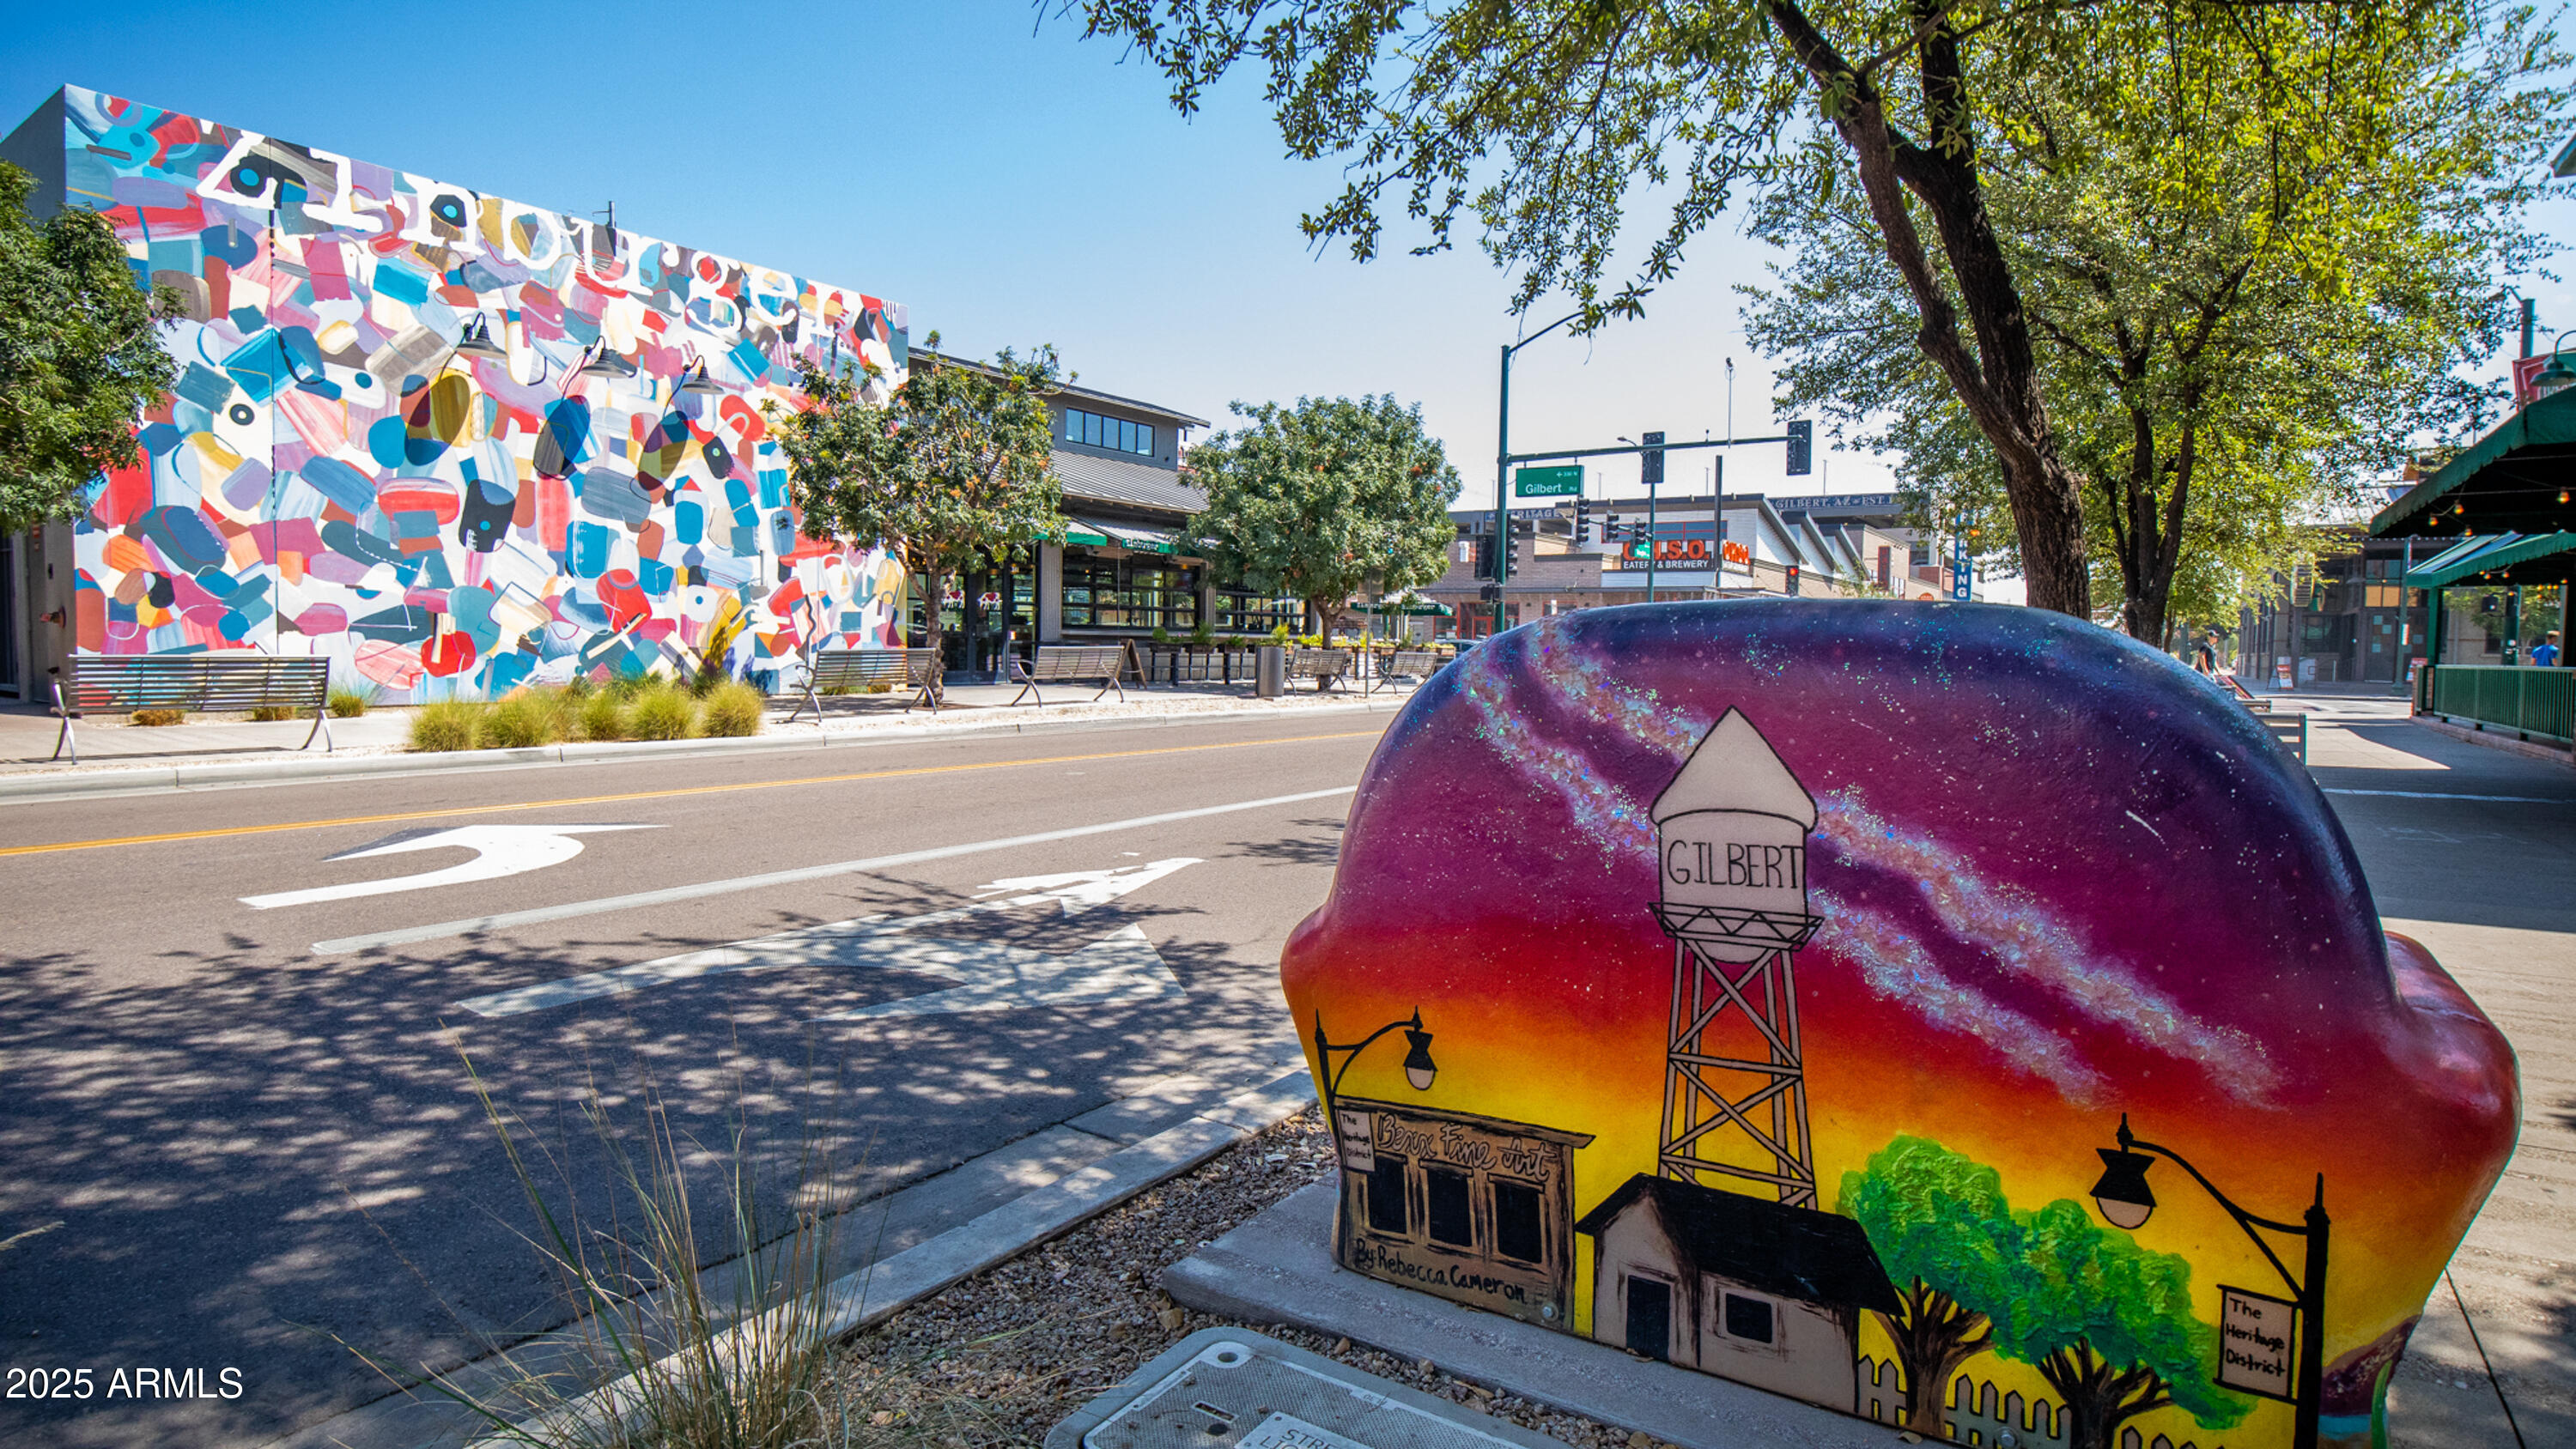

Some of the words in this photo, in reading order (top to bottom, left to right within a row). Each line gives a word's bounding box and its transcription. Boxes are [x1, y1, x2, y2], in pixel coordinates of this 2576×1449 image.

[1525, 482, 1562, 494] Gilbert
[1834, 496, 1850, 506] AZ
[1666, 560, 1709, 568] BREWERY
[1668, 840, 1803, 888] GILBERT
[1341, 1113, 1357, 1125] The
[1440, 1121, 1498, 1171] Fine
[1498, 1137, 1556, 1181] Art
[1377, 1245, 1448, 1286] Rebecca
[1449, 1264, 1528, 1304] Cameron
[2229, 1297, 2262, 1319] The
[2226, 1323, 2285, 1352] Heritage
[2226, 1349, 2286, 1377] District
